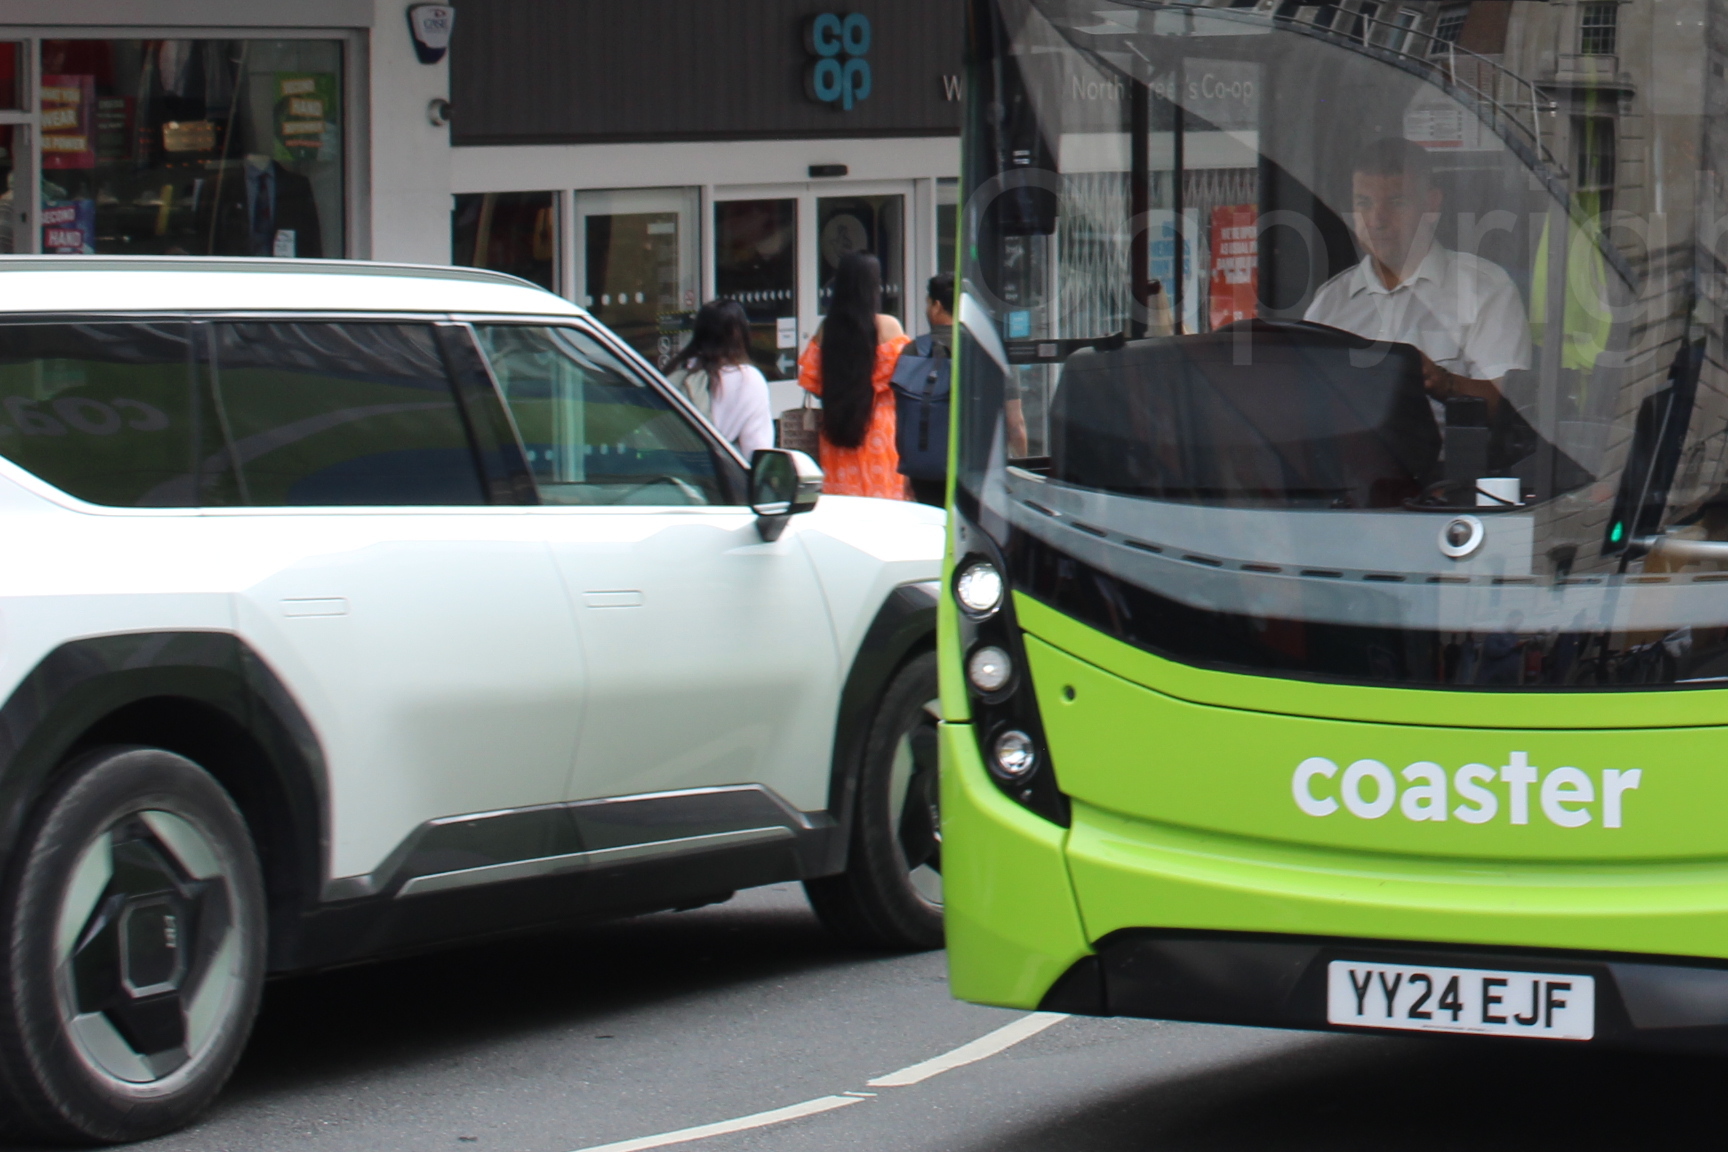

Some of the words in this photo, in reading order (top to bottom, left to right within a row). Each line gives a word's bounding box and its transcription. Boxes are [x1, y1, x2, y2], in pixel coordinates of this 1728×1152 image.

[1072, 74, 1124, 101] North
[1202, 73, 1254, 107] Co-op
[1290, 749, 1642, 830] coaster
[1348, 968, 1465, 1023] YY24
[1481, 976, 1573, 1029] EJF
